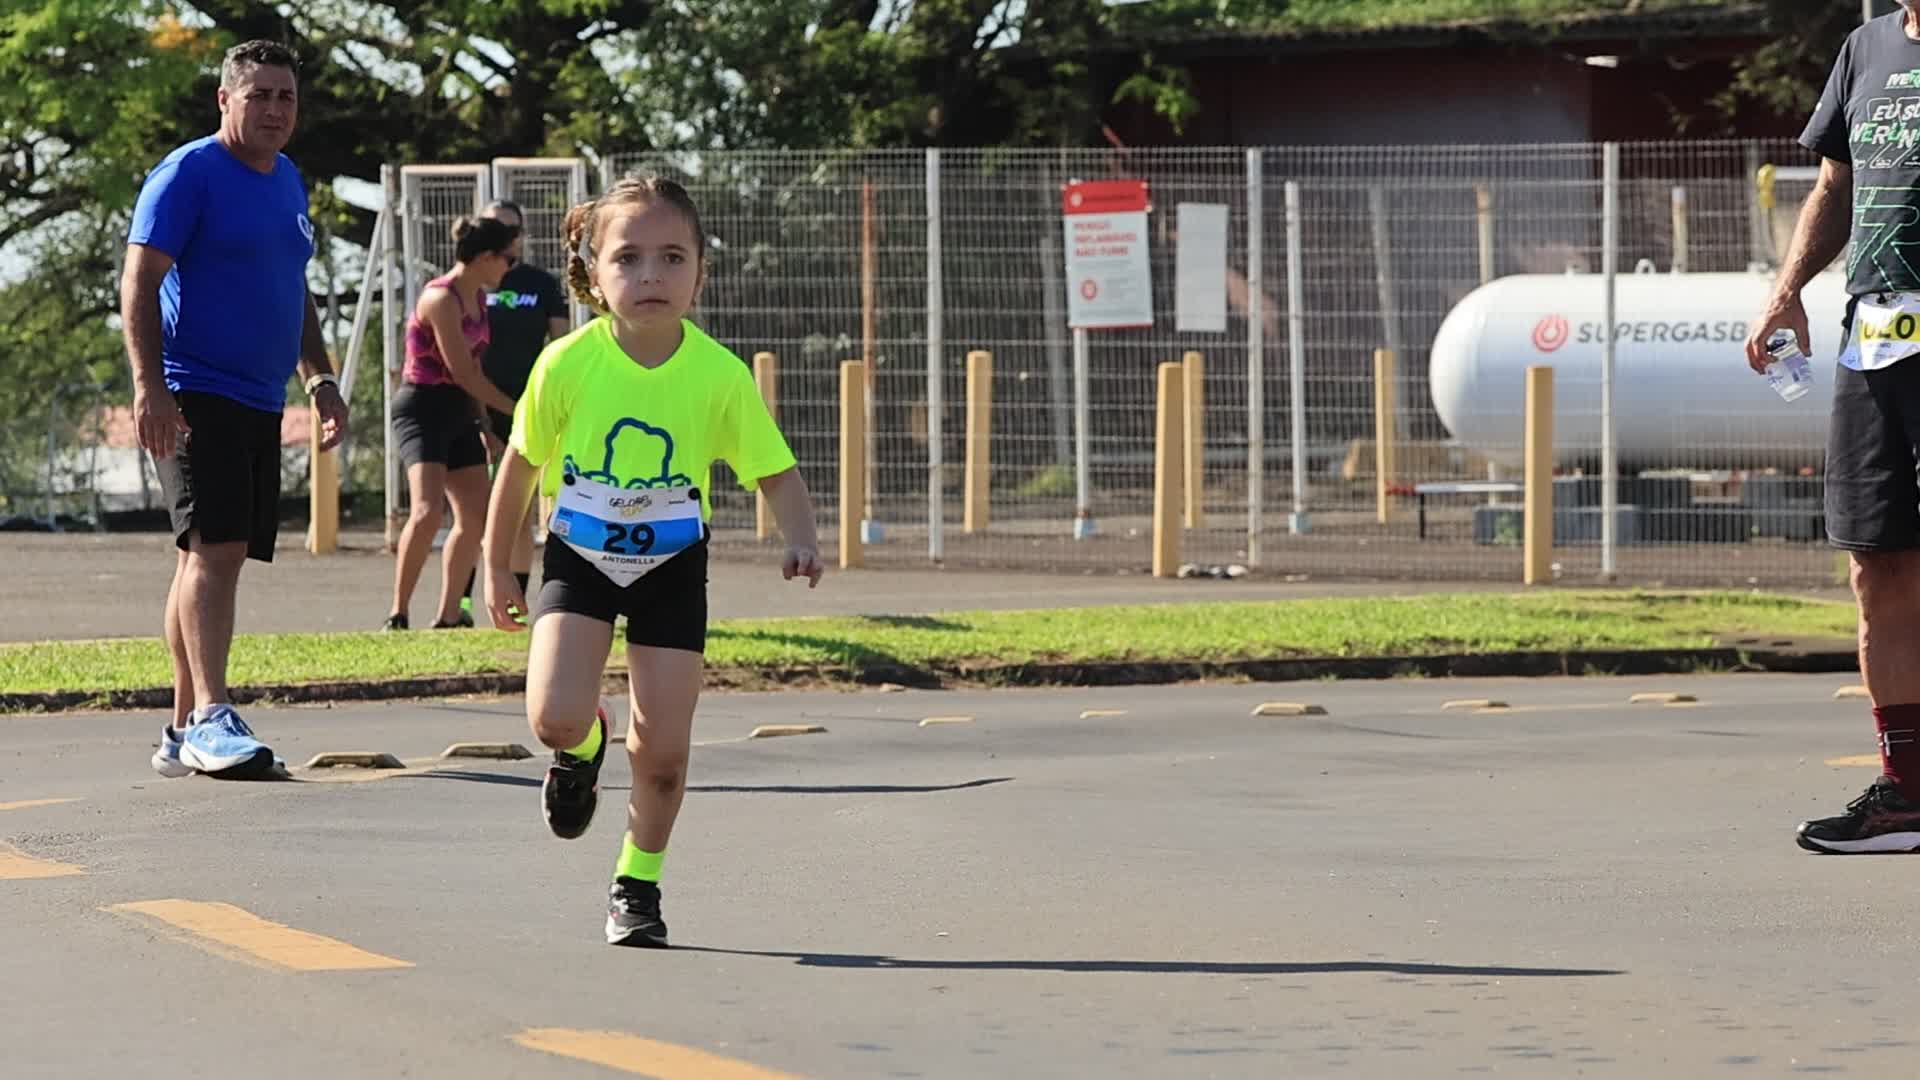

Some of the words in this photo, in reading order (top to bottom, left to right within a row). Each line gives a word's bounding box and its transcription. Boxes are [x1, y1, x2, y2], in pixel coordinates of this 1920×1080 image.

[1577, 321, 1748, 343] SUPERGASB
[603, 523, 656, 555] 29
[601, 555, 656, 565] ANTONELLA
